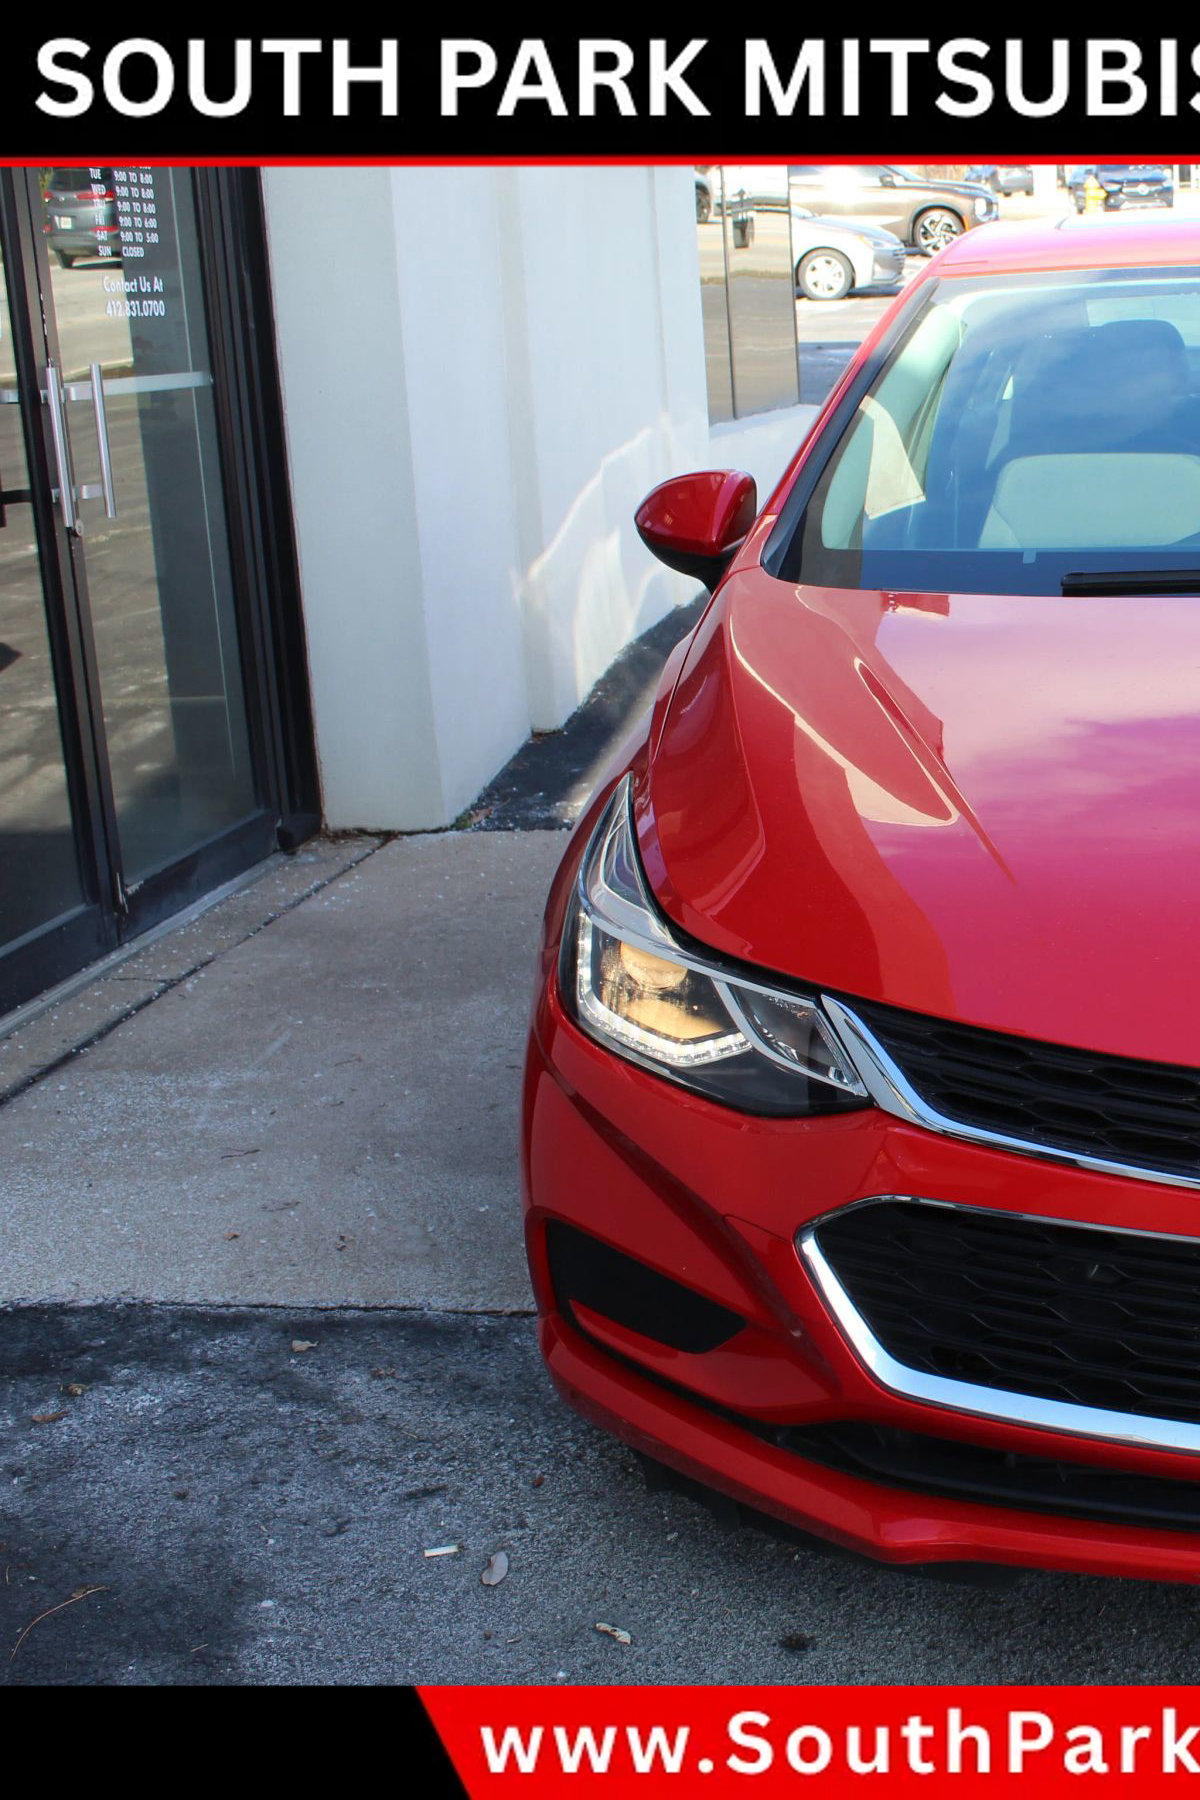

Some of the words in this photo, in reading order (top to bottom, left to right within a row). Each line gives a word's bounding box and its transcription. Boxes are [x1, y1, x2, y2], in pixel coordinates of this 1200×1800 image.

[89, 168, 102, 180] TUE
[114, 171, 127, 182] 9:00
[129, 172, 137, 183] TO
[91, 184, 106, 195] WED
[115, 186, 129, 197] 9:00
[131, 187, 139, 198] TO
[117, 201, 130, 212] 9:00
[132, 202, 141, 213] TO
[95, 215, 105, 225] FRI
[118, 216, 132, 227] 9:00
[134, 217, 142, 228] TO
[144, 218, 157, 229] 6:00
[96, 230, 108, 241] SAT
[120, 231, 133, 242] 9:00
[134, 232, 143, 243] TO
[146, 233, 159, 243] 5:00
[98, 245, 112, 256] SUN
[122, 246, 145, 258] CLOSED
[103, 276, 138, 293] Contact
[139, 276, 151, 292] Us
[153, 277, 164, 293] At
[106, 300, 165, 317] 412.831.0700
